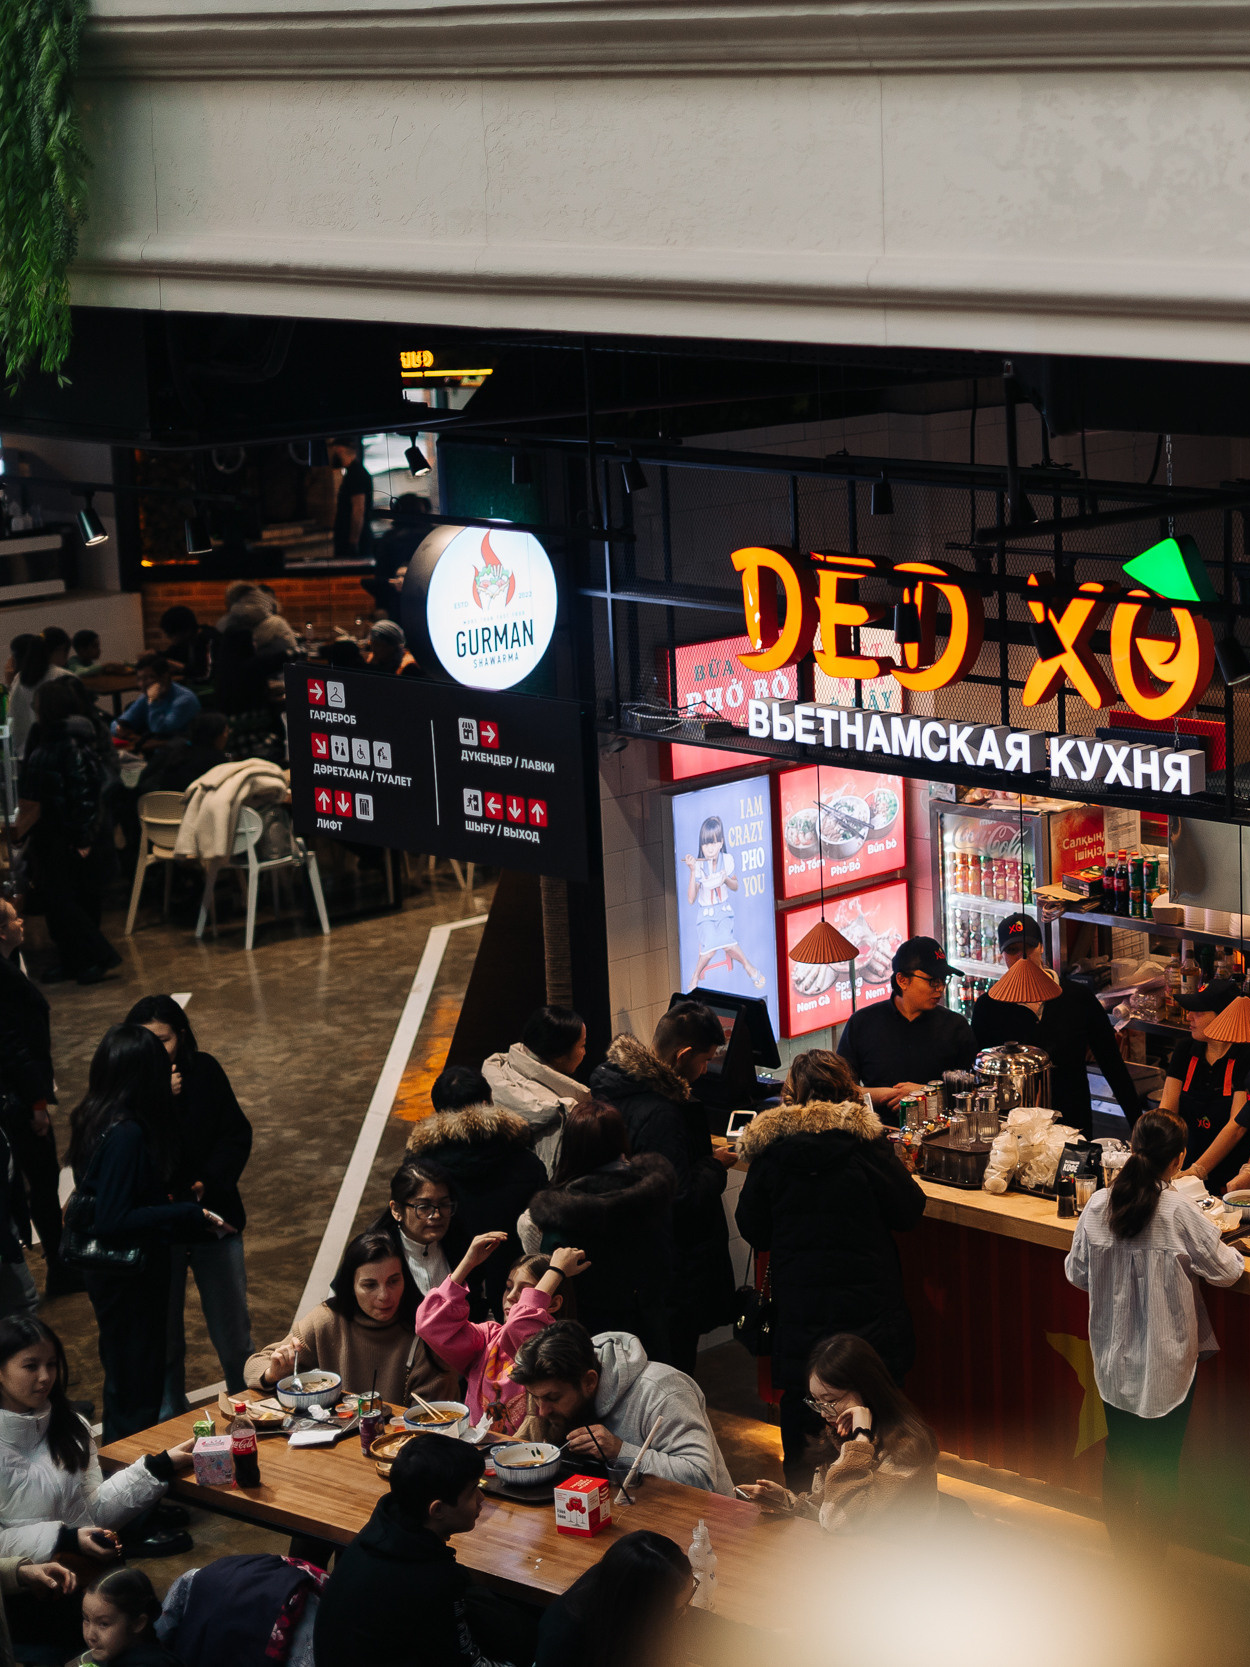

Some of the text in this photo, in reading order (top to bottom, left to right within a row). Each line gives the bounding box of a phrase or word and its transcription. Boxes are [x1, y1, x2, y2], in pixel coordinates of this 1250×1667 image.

[731, 547, 970, 691] DED
[455, 618, 534, 658] GURMAN
[473, 651, 519, 669] SHAWARMA
[309, 709, 357, 725] ГАРДЕРОБ
[748, 699, 1191, 796] ВЬЕТНАМСКАЯ КУХНЯ
[460, 749, 513, 767] ДҮКЕНДЕР
[520, 758, 556, 773] ЛАВКИ
[313, 763, 369, 781] ДӘРЕТХАНА
[375, 772, 413, 787] ТУАЛЕТ
[740, 794, 764, 820] I AM
[316, 818, 343, 832] ЛИФТ
[465, 820, 496, 835] ШЫҒУ
[503, 826, 541, 844] ВЫХОД
[728, 820, 764, 848] CRAZY
[1062, 831, 1105, 850] Салқын
[741, 846, 765, 872] PHO
[743, 873, 765, 897] YOU
[835, 976, 864, 993] Sprg
[840, 987, 862, 1001] Ros
[865, 986, 886, 1001] Nem
[796, 998, 818, 1014] Nem
